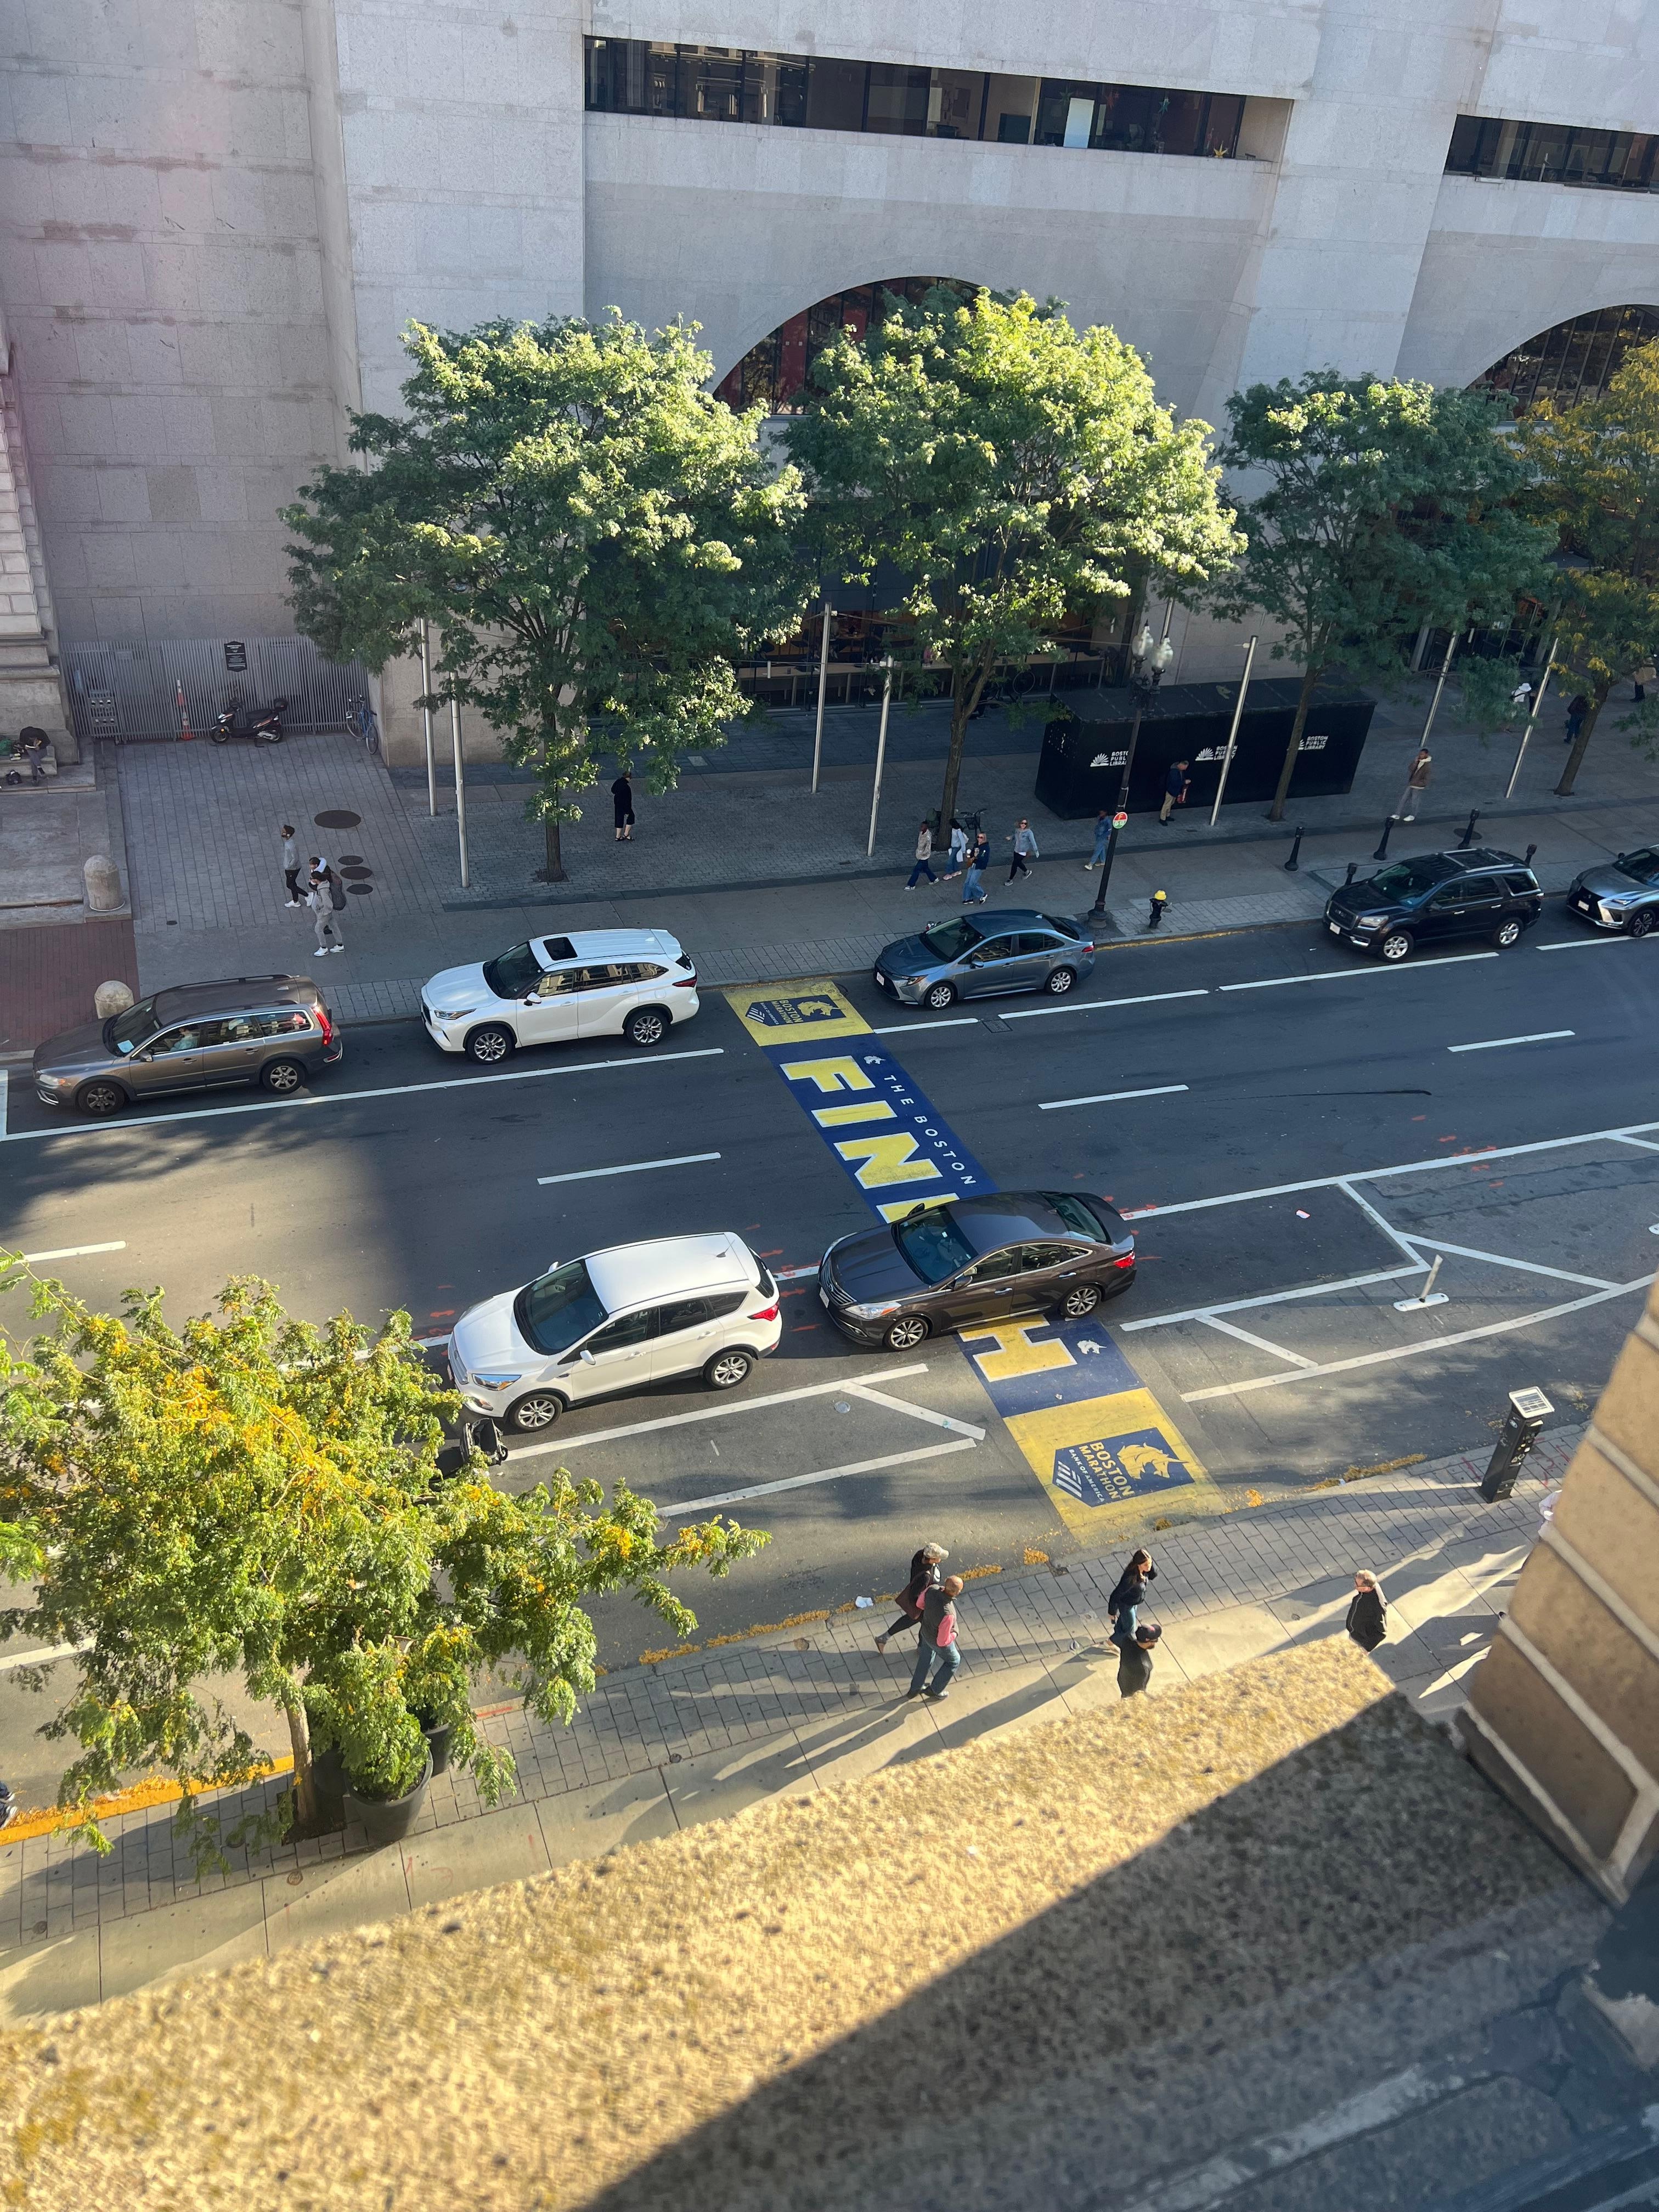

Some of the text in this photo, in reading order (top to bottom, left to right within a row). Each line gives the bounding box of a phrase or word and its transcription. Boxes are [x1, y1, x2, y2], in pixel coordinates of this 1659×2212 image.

[771, 1001, 793, 1024] MARATHON
[779, 1000, 803, 1023] BOSTON
[884, 1075, 976, 1185] THE BOSTON
[779, 1055, 1077, 1382] FINIH
[1069, 1449, 1105, 1503] BANK OF AMERICA
[1079, 1445, 1121, 1499] MARATHON
[1090, 1442, 1135, 1496] BOSTON
